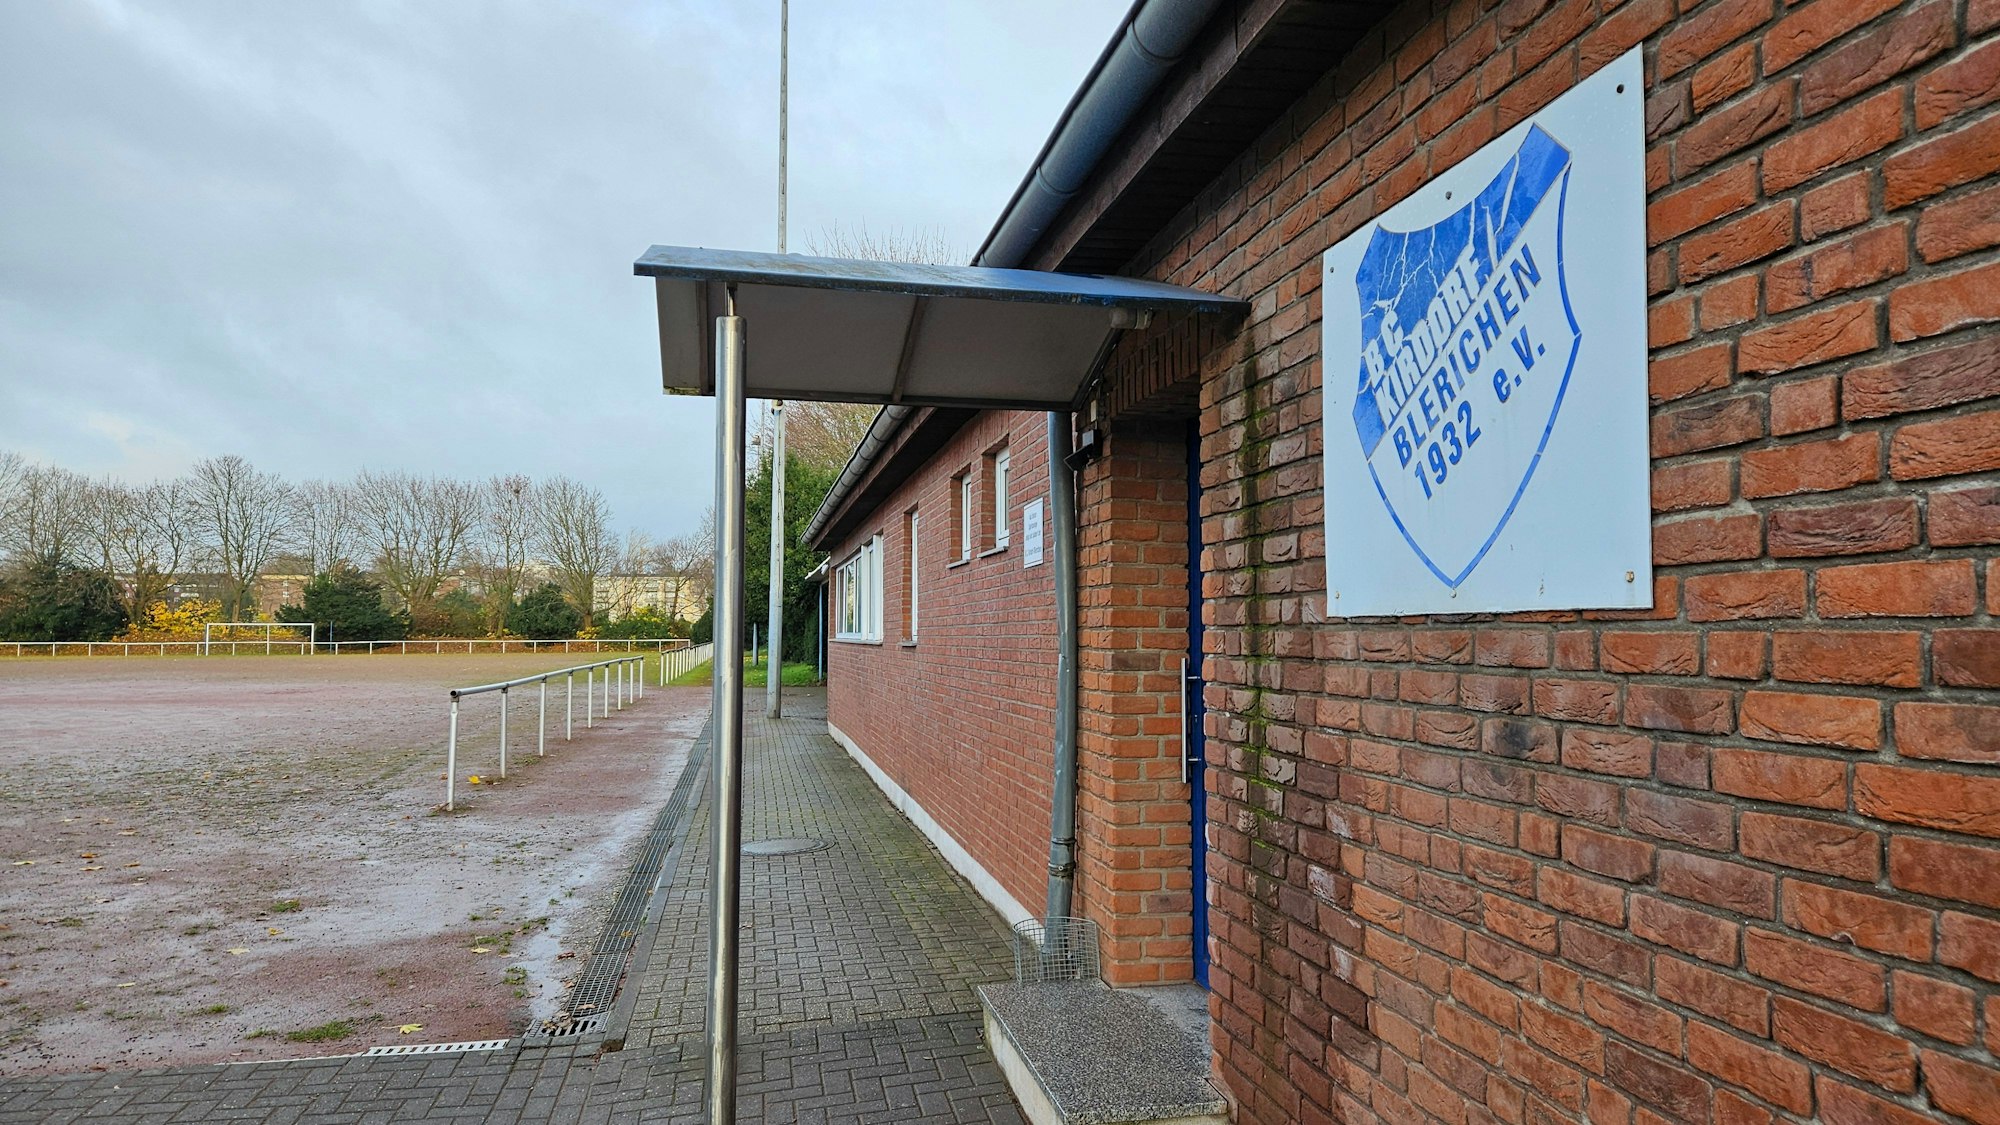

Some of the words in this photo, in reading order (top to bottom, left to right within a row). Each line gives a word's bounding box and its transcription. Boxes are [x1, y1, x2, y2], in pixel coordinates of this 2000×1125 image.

[1375, 243, 1481, 430] KIRDORF
[1392, 243, 1542, 469] BLERICHEN
[1414, 401, 1481, 500] 1932
[1493, 325, 1546, 403] e.V.
